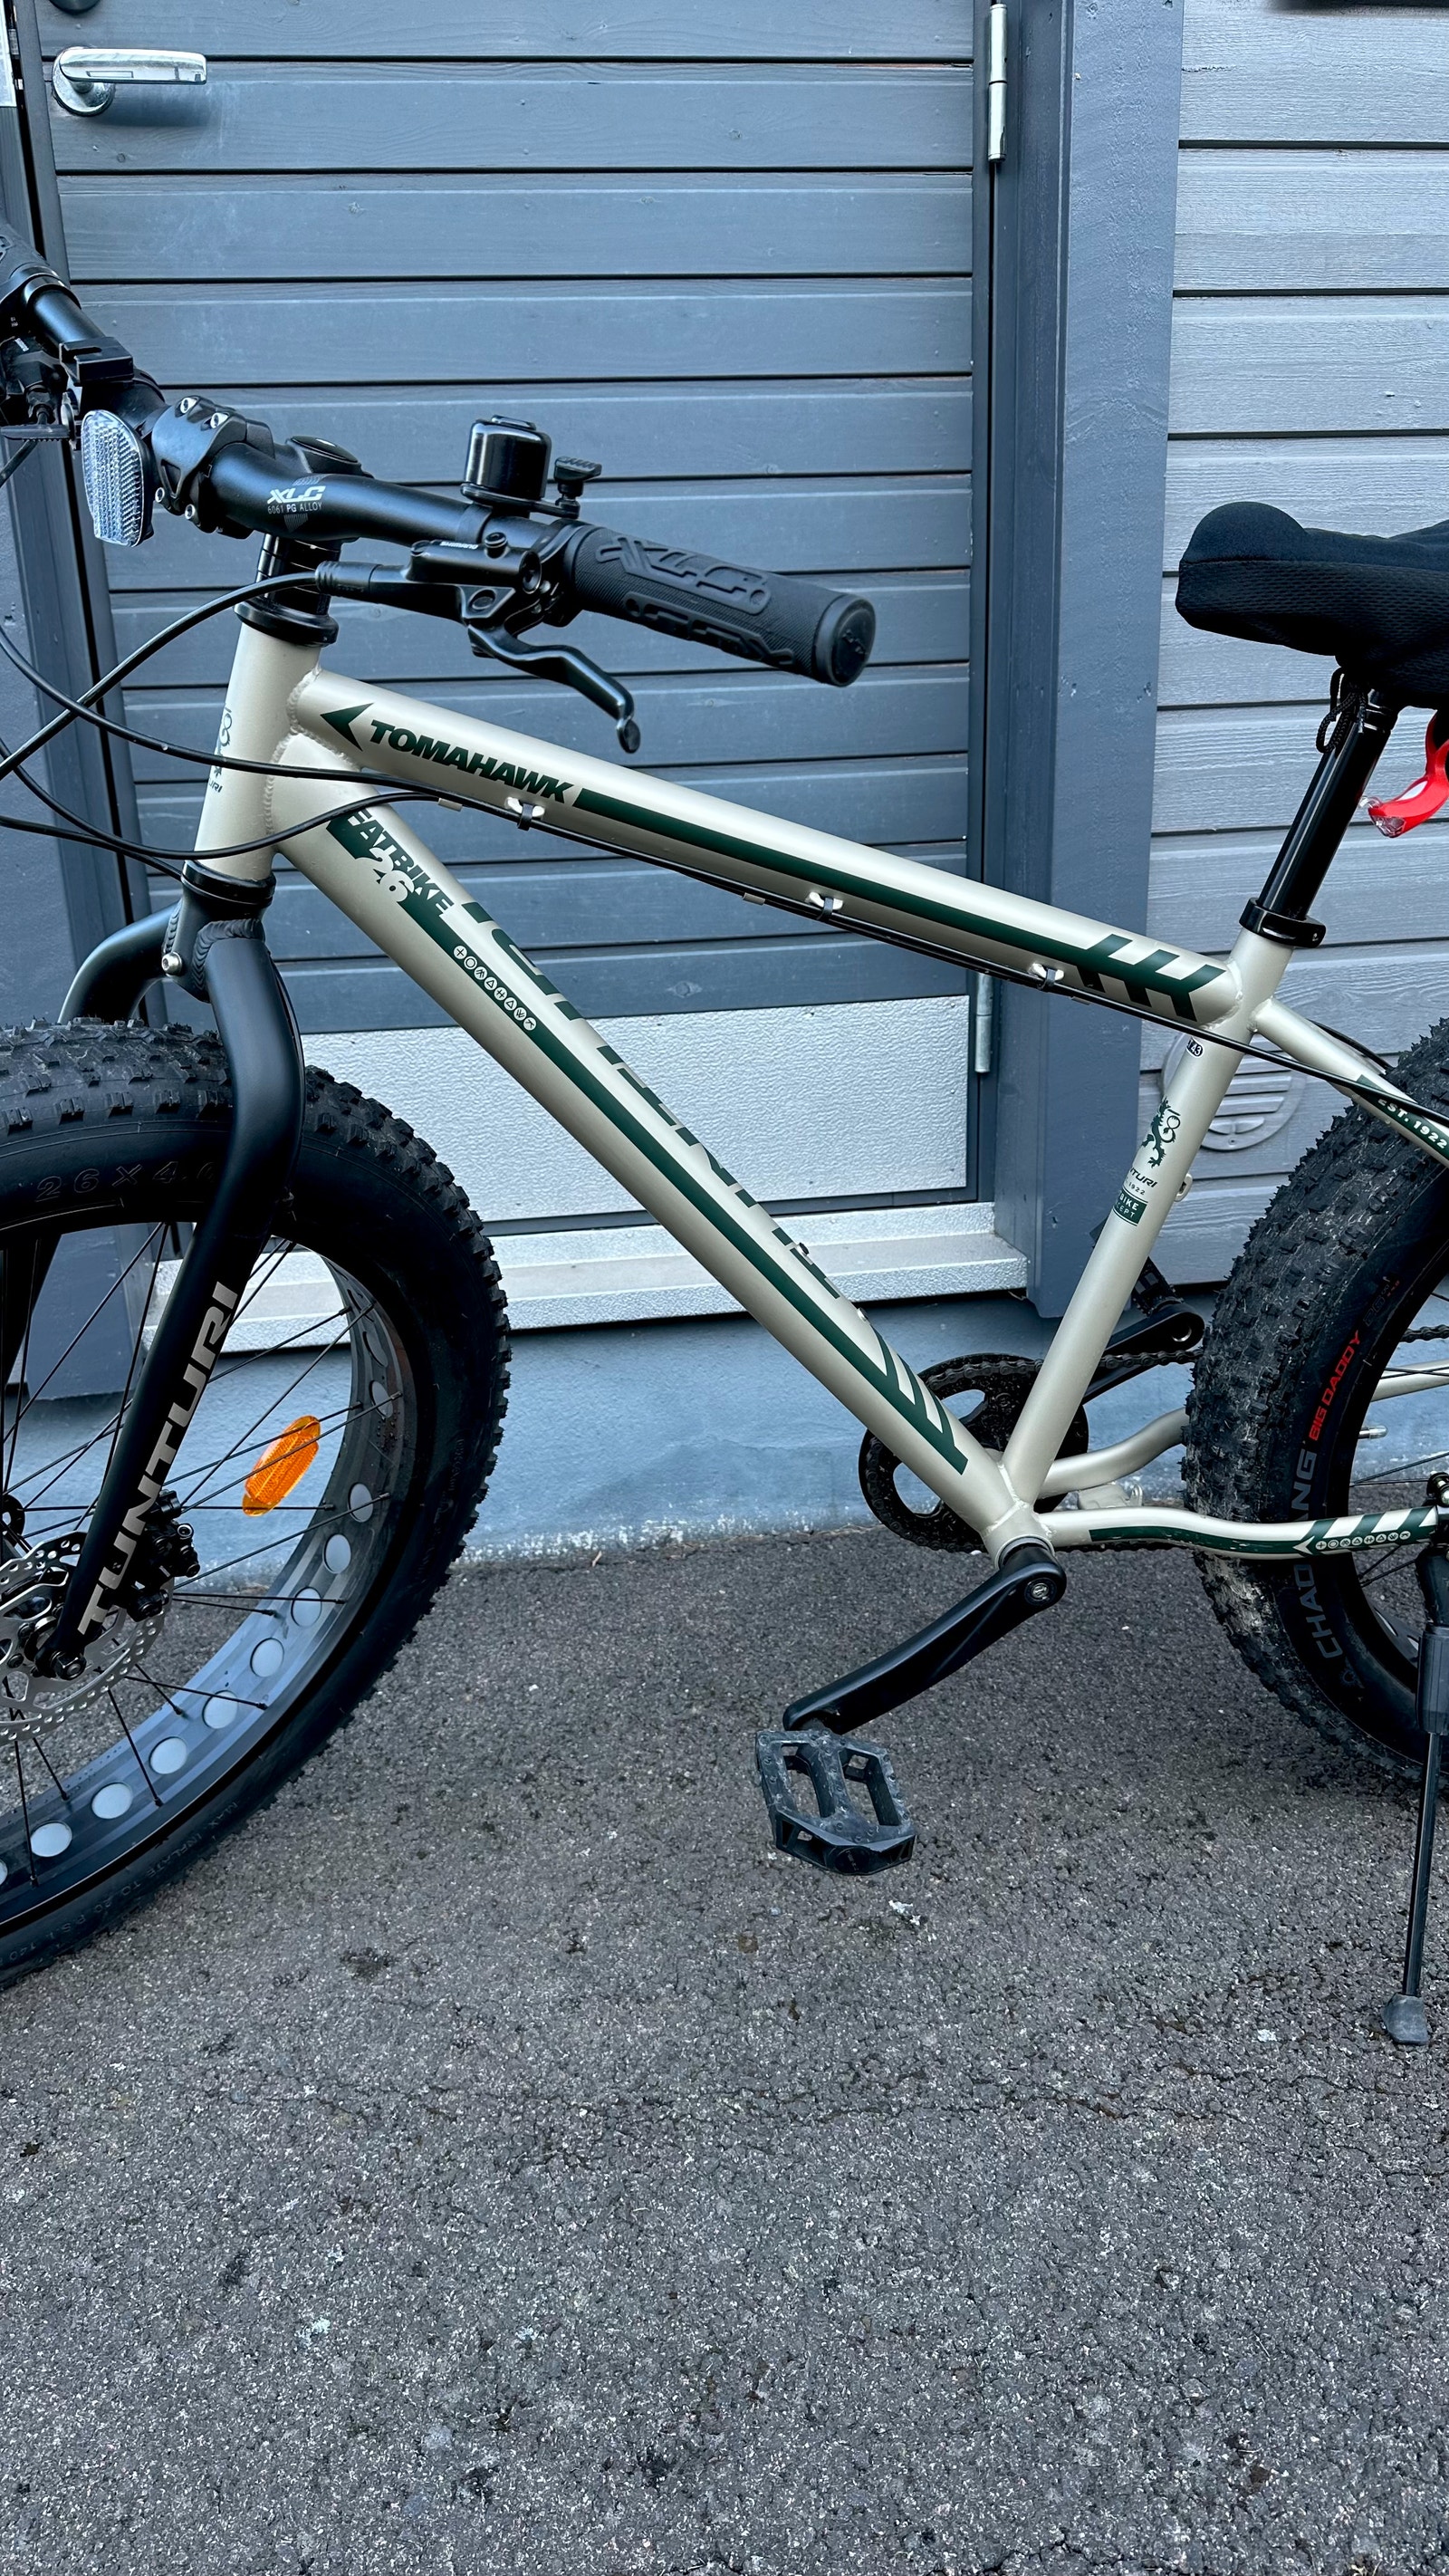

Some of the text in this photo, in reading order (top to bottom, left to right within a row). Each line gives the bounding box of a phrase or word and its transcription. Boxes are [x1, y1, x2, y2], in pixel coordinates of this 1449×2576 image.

[267, 485, 326, 505] XLC
[267, 501, 322, 514] 6061 PG ALLOY
[369, 719, 574, 804] TOMAHAWK
[354, 846, 417, 903] 26
[1413, 1120, 1448, 1149] 1922
[1309, 1330, 1360, 1441] BIG DADDY
[78, 1281, 238, 1636] TUNTURI
